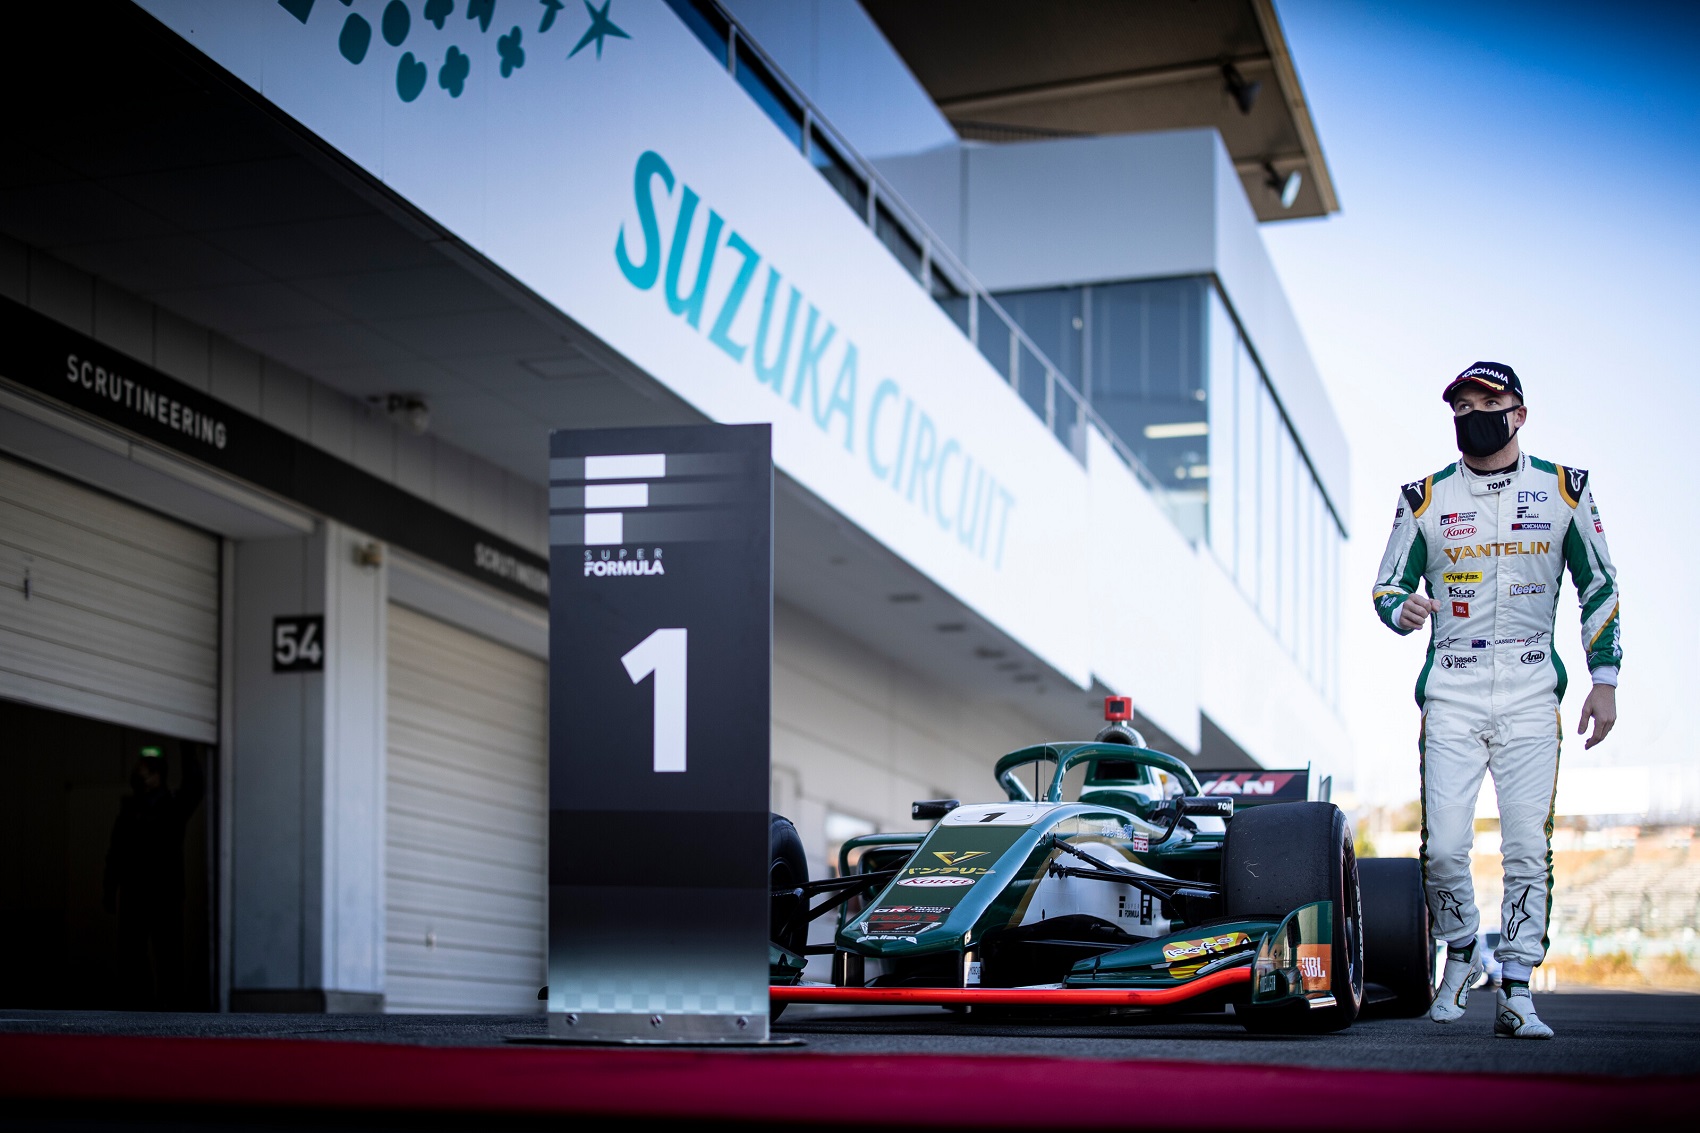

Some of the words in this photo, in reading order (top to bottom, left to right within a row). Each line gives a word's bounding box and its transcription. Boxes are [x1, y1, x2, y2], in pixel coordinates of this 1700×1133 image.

[615, 150, 859, 455] SUZUKA
[866, 377, 1016, 572] CIRCUIT
[1462, 368, 1508, 384] YOKOHAMA
[66, 354, 227, 449] SCRUTINEERING
[1487, 478, 1512, 490] TOM'S
[1517, 491, 1549, 503] ENG
[1441, 517, 1458, 525] GR
[1445, 526, 1477, 538] Kowa
[584, 548, 663, 560] SUPER
[1443, 541, 1550, 565] VANTELIN
[584, 560, 665, 577] FORMULA
[276, 623, 321, 664] 54
[621, 628, 688, 773] 1
[979, 811, 1008, 823] 1
[1124, 910, 1140, 919] FORMULA
[1303, 956, 1325, 978] JBL
